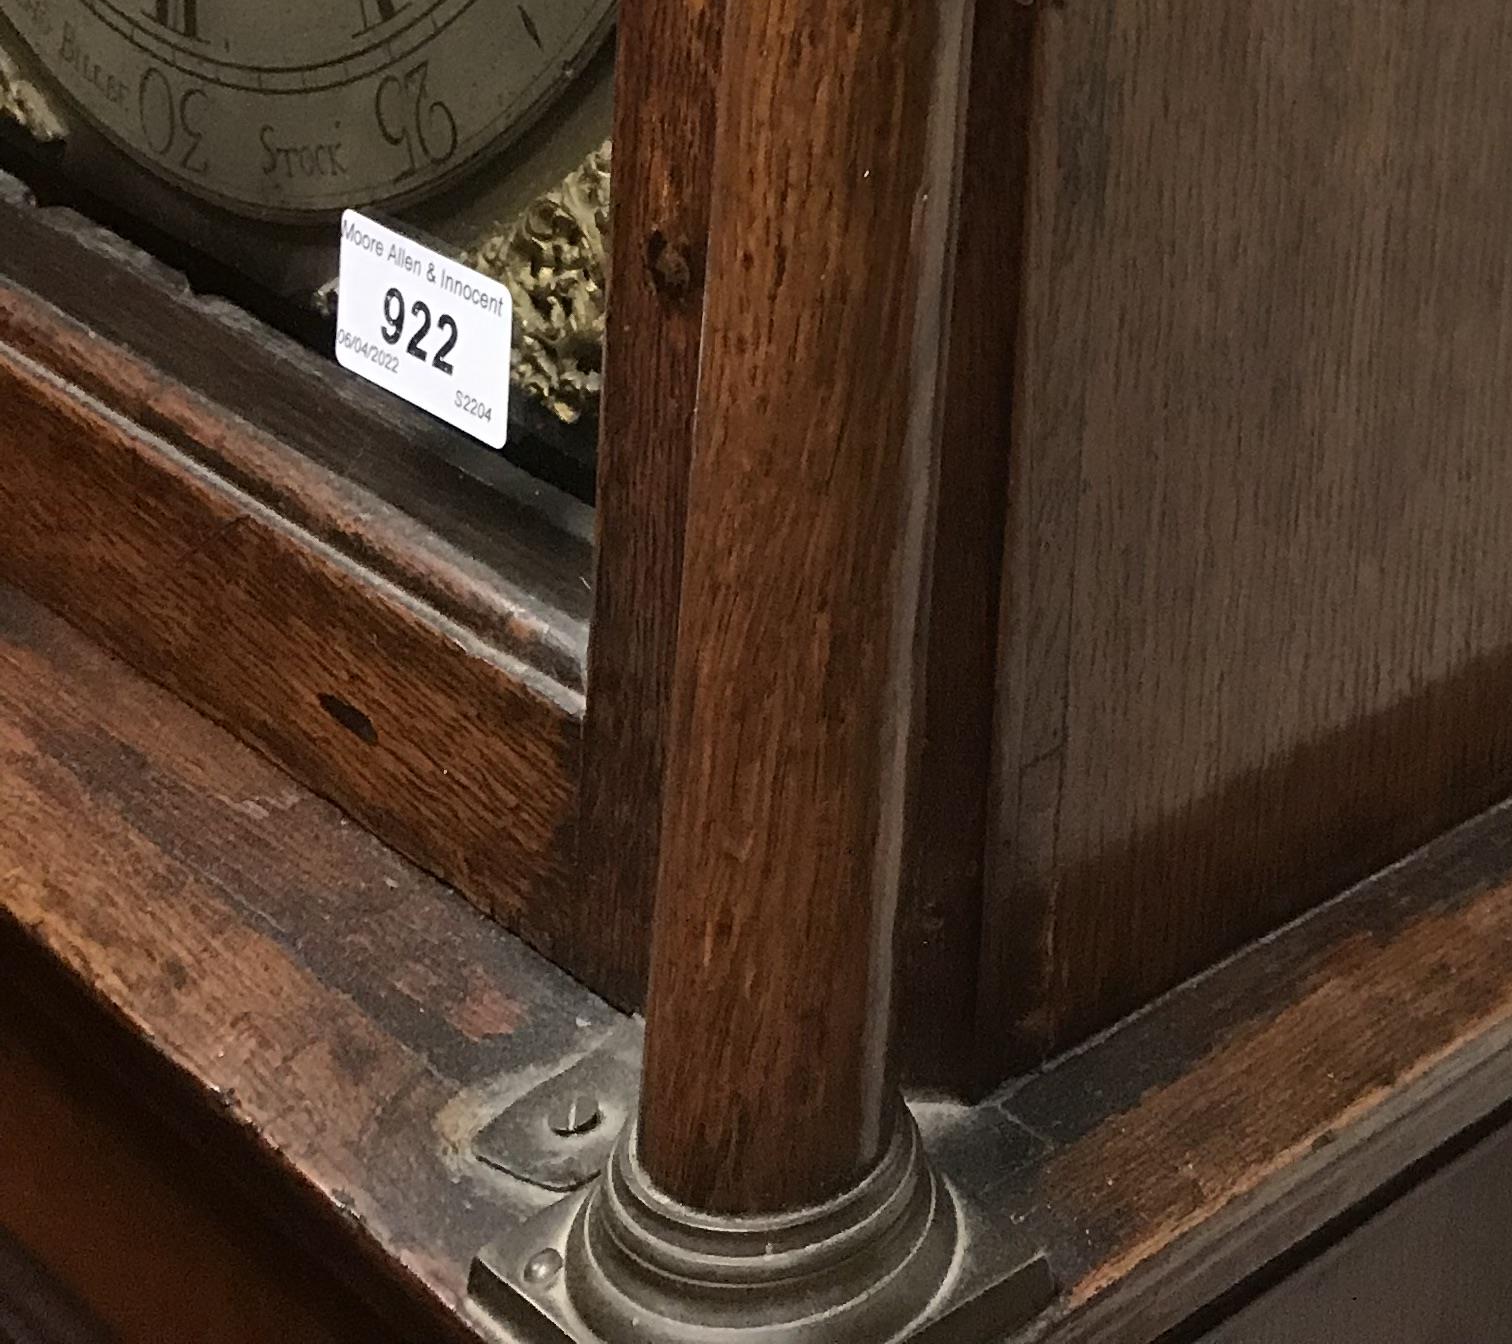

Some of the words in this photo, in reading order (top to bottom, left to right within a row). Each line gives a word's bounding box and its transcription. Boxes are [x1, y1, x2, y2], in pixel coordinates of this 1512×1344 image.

[139, 68, 208, 173] 30
[375, 60, 457, 184] 25
[341, 219, 384, 258] Moore
[387, 244, 422, 276] Allen
[426, 262, 437, 284] &
[440, 269, 504, 317] Innocent
[337, 328, 400, 375] 06/04/2022
[380, 287, 459, 376] 922
[454, 390, 493, 424] S2204
